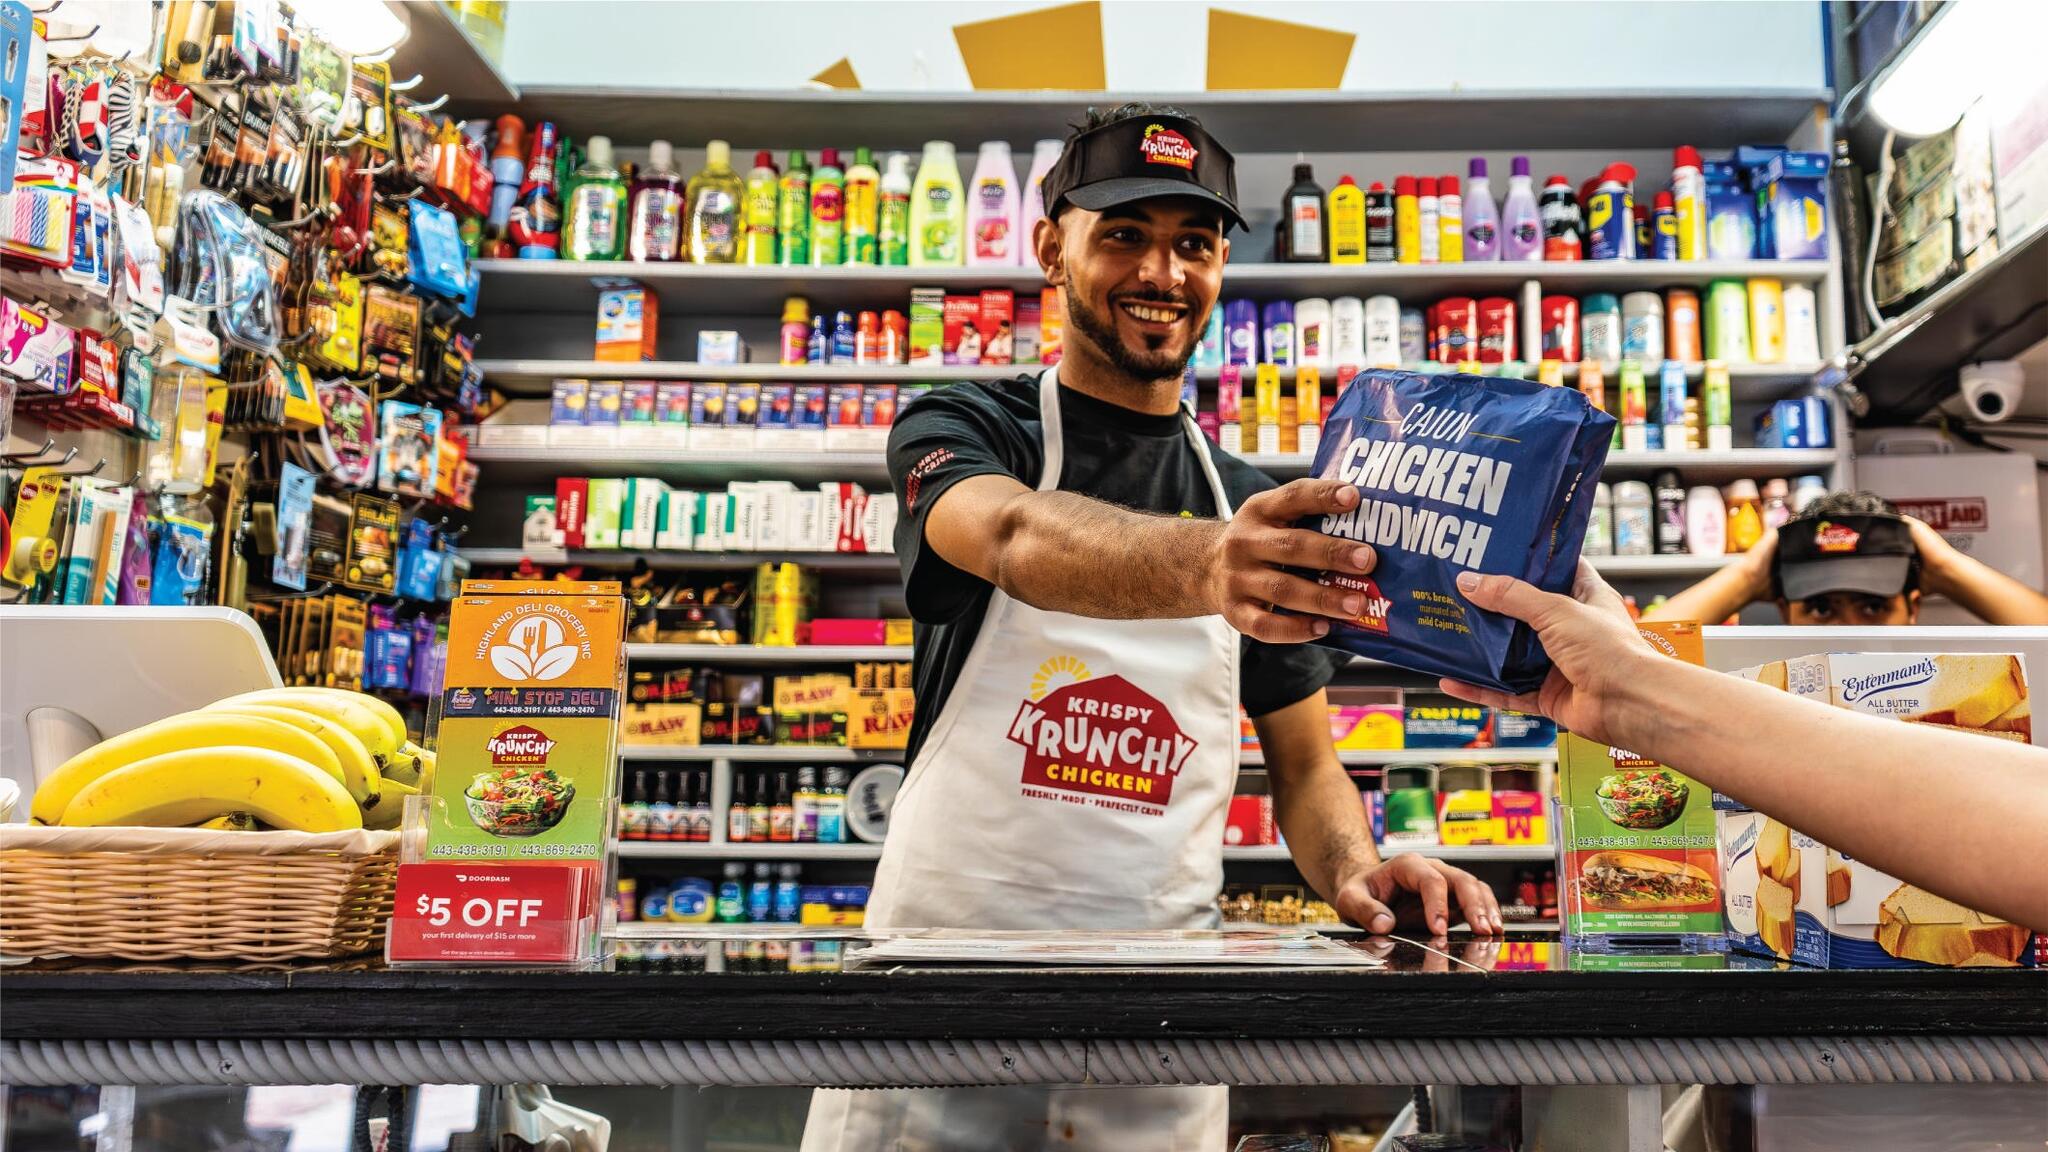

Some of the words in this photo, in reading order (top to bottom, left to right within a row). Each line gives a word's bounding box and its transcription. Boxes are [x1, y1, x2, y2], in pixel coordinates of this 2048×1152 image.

[1141, 139, 1198, 160] KRUNCHY
[1157, 135, 1184, 145] KRISPY
[1153, 154, 1190, 165] CHICKEN
[1399, 402, 1479, 443] CAJUN
[1339, 437, 1512, 516] CHICKEN
[1951, 506, 1982, 522] AID
[476, 611, 514, 660] HIGHLAND
[515, 603, 542, 614] DELI
[544, 603, 588, 641] GROCERY
[580, 639, 592, 660] INC
[1842, 658, 1937, 701] Entenmann's
[524, 691, 565, 706] STOP
[571, 692, 605, 706] DELI
[1067, 697, 1153, 724] KRISPY
[488, 738, 555, 755] KRUNCHY
[1010, 704, 1196, 776] KRUNCHY
[1046, 764, 1152, 794] CHICKEN
[1021, 788, 1058, 801] FRESHLY
[1061, 793, 1086, 805] MADE
[1094, 799, 1140, 814] PERFECTLY
[1140, 806, 1164, 817] CAJUN
[432, 844, 508, 856] 443-438-3191
[511, 844, 518, 856] /
[520, 844, 596, 856] 443-869-2470
[416, 894, 451, 926] $5
[462, 898, 543, 927] OFF
[422, 932, 438, 941] your
[455, 932, 484, 941] delivery
[486, 932, 494, 940] of
[494, 932, 508, 940] $15
